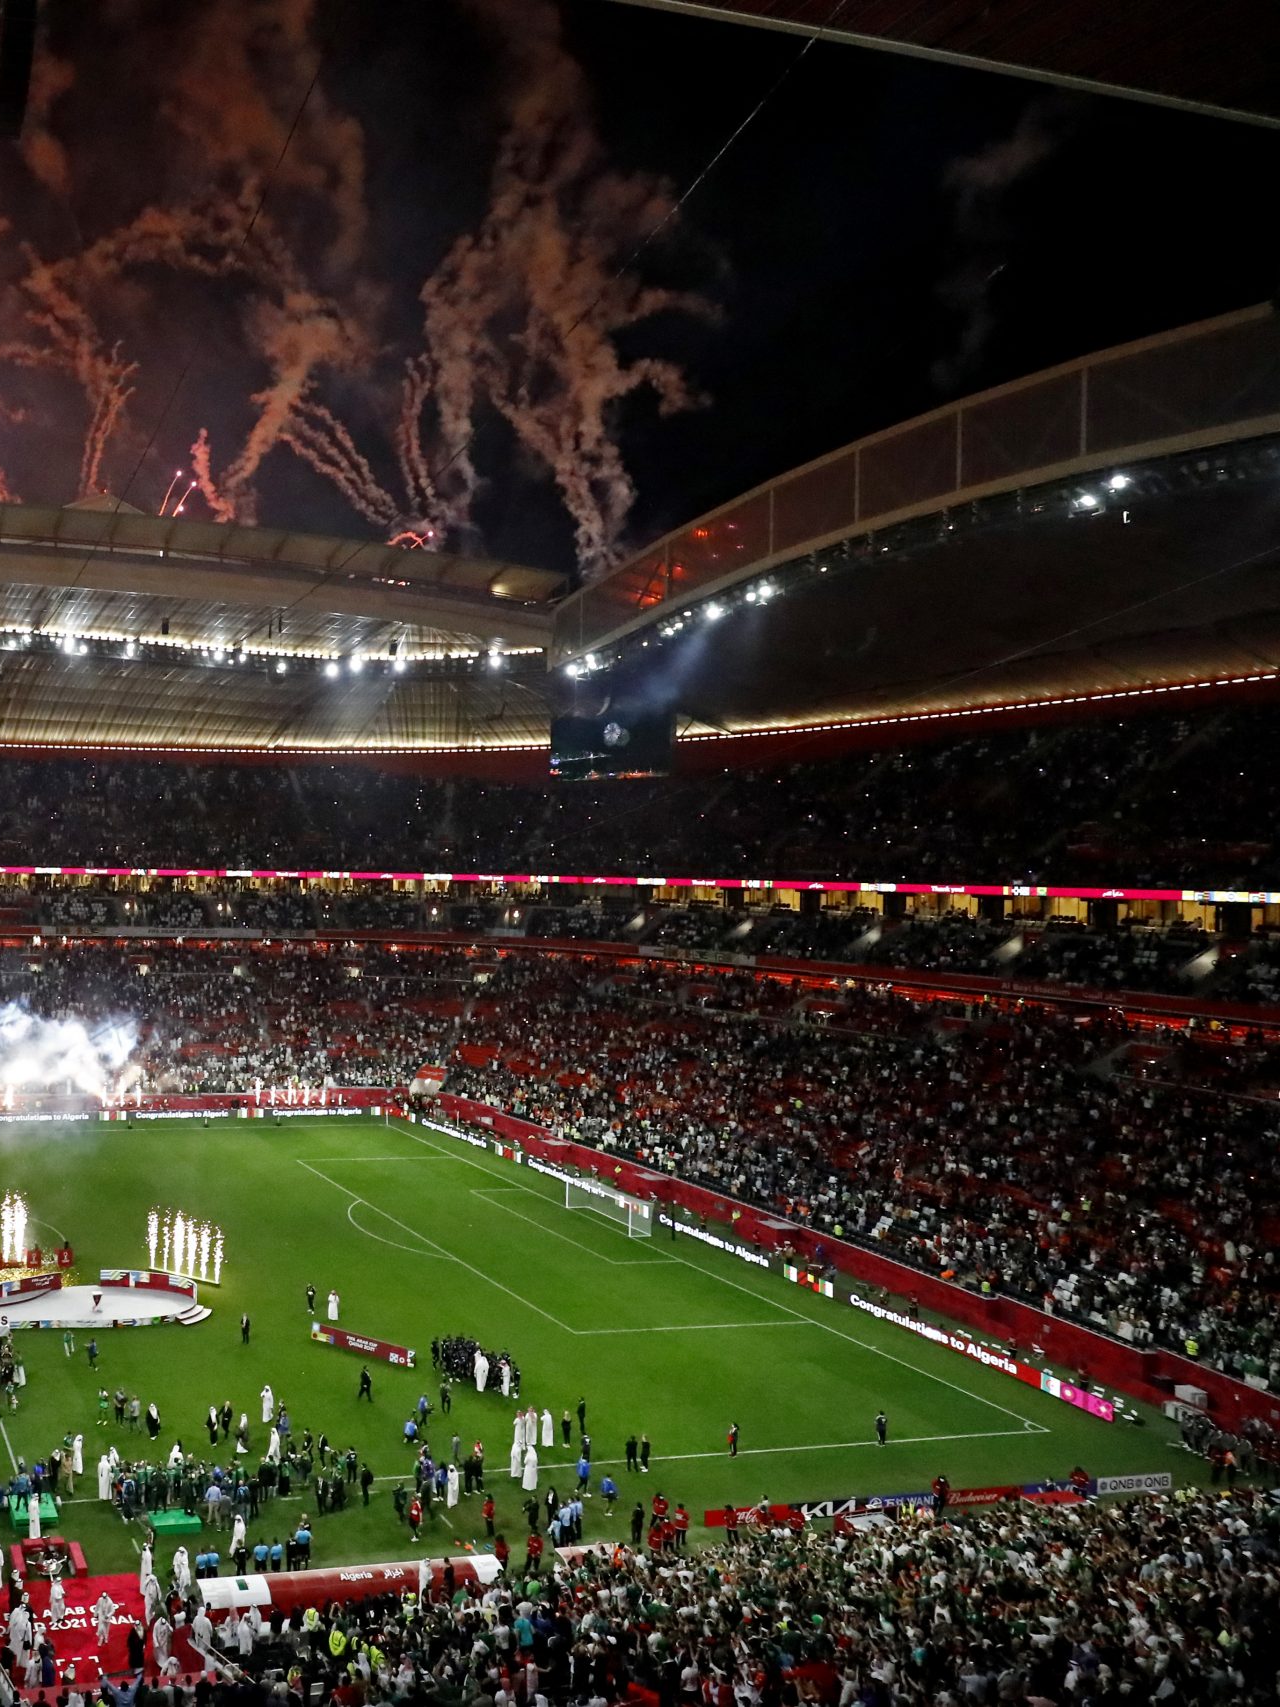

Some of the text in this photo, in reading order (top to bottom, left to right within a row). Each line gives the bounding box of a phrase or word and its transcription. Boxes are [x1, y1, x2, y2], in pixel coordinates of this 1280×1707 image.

[62, 1113, 89, 1121] Algeria
[136, 1111, 193, 1120] Congratulations
[272, 1108, 328, 1117] Congratulations
[337, 1108, 362, 1116] Algeria
[850, 1294, 1017, 1375] Congratulations to Algeria
[1109, 1476, 1169, 1491] QNB QNB
[340, 1571, 373, 1581] Algeria
